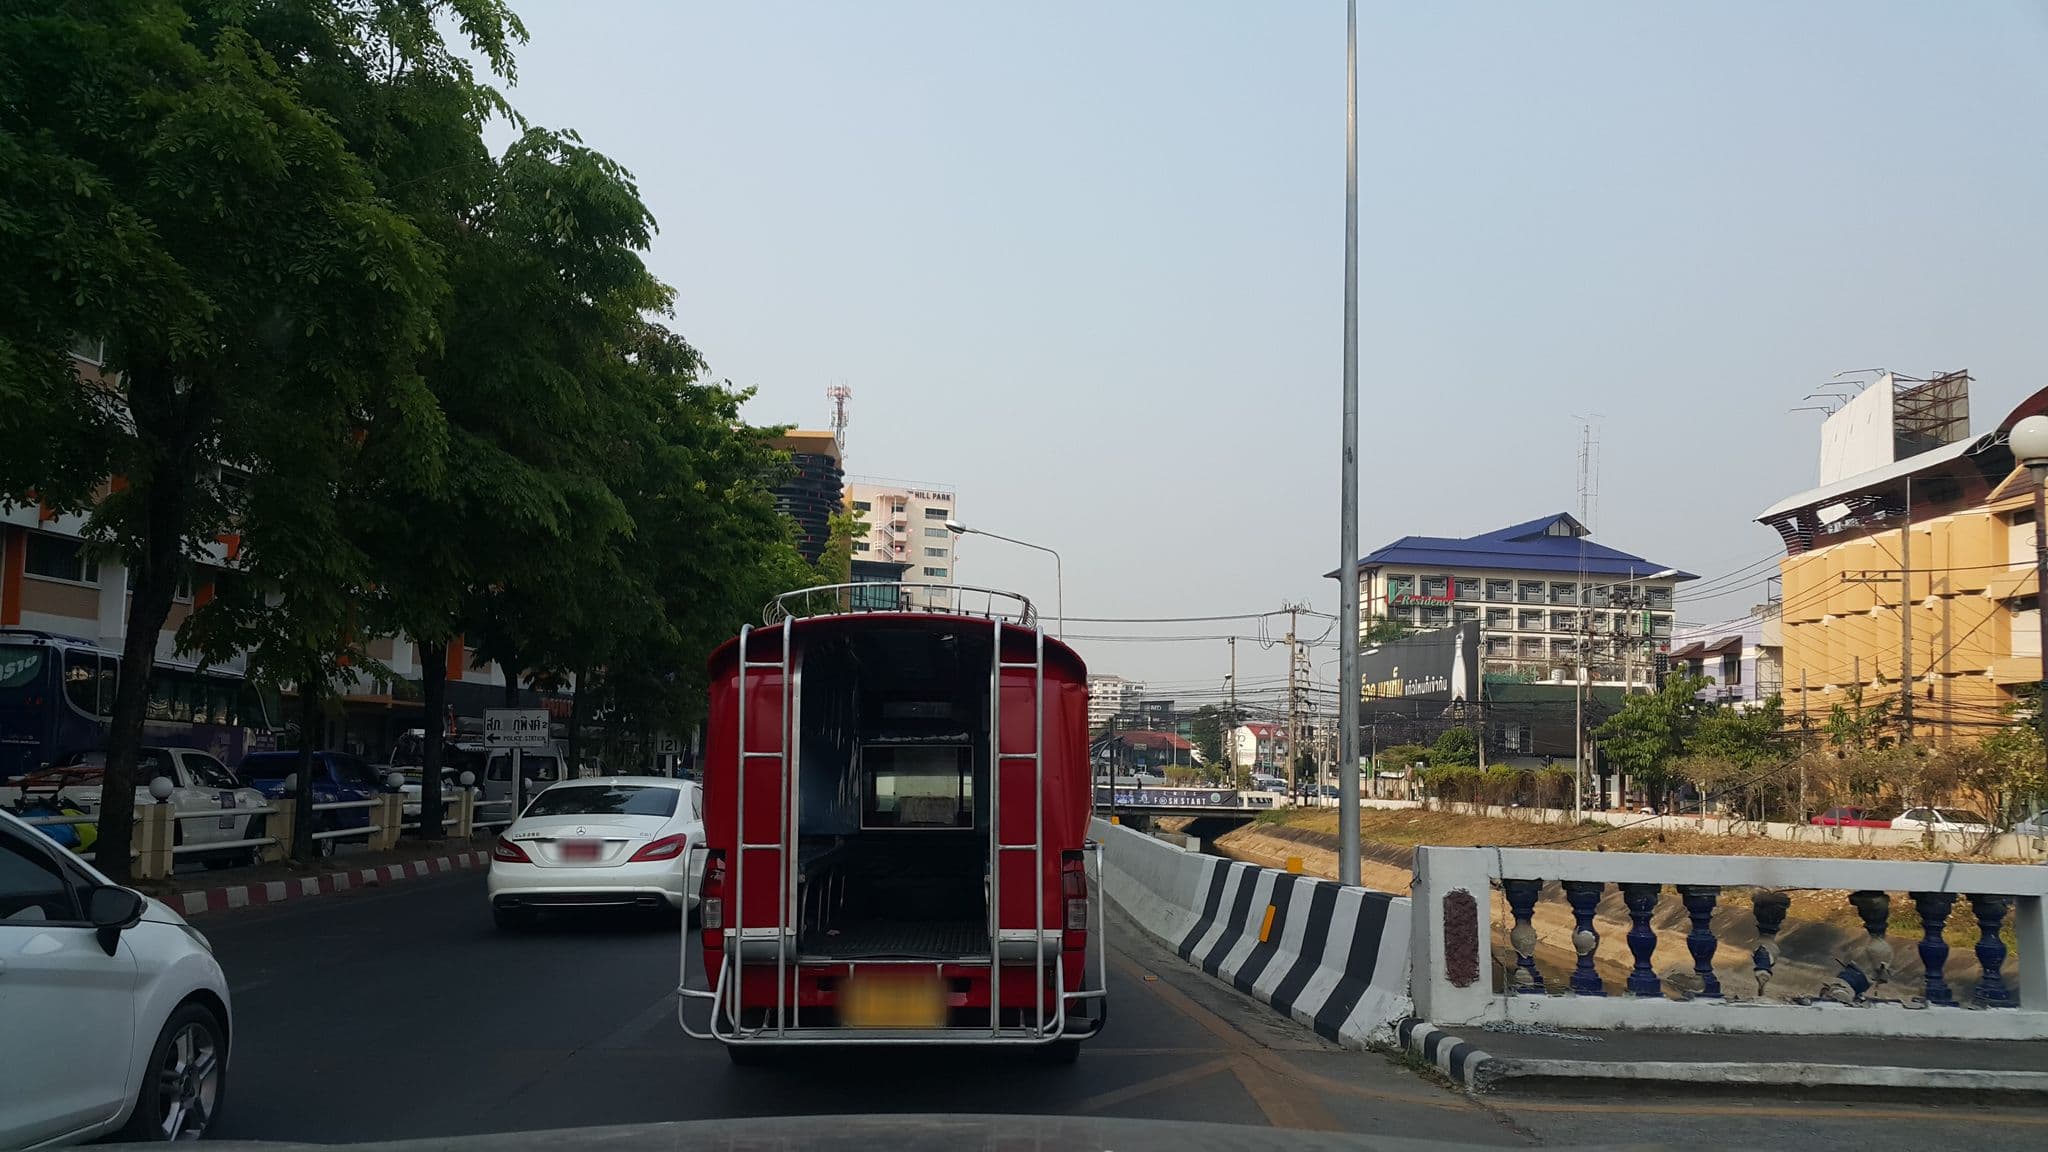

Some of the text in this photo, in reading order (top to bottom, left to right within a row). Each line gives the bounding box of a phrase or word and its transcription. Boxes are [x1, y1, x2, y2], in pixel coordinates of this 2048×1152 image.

[915, 491, 931, 499] HILL
[932, 493, 951, 501] PARK
[1401, 595, 1454, 607] Residence
[1181, 797, 1206, 805] START
